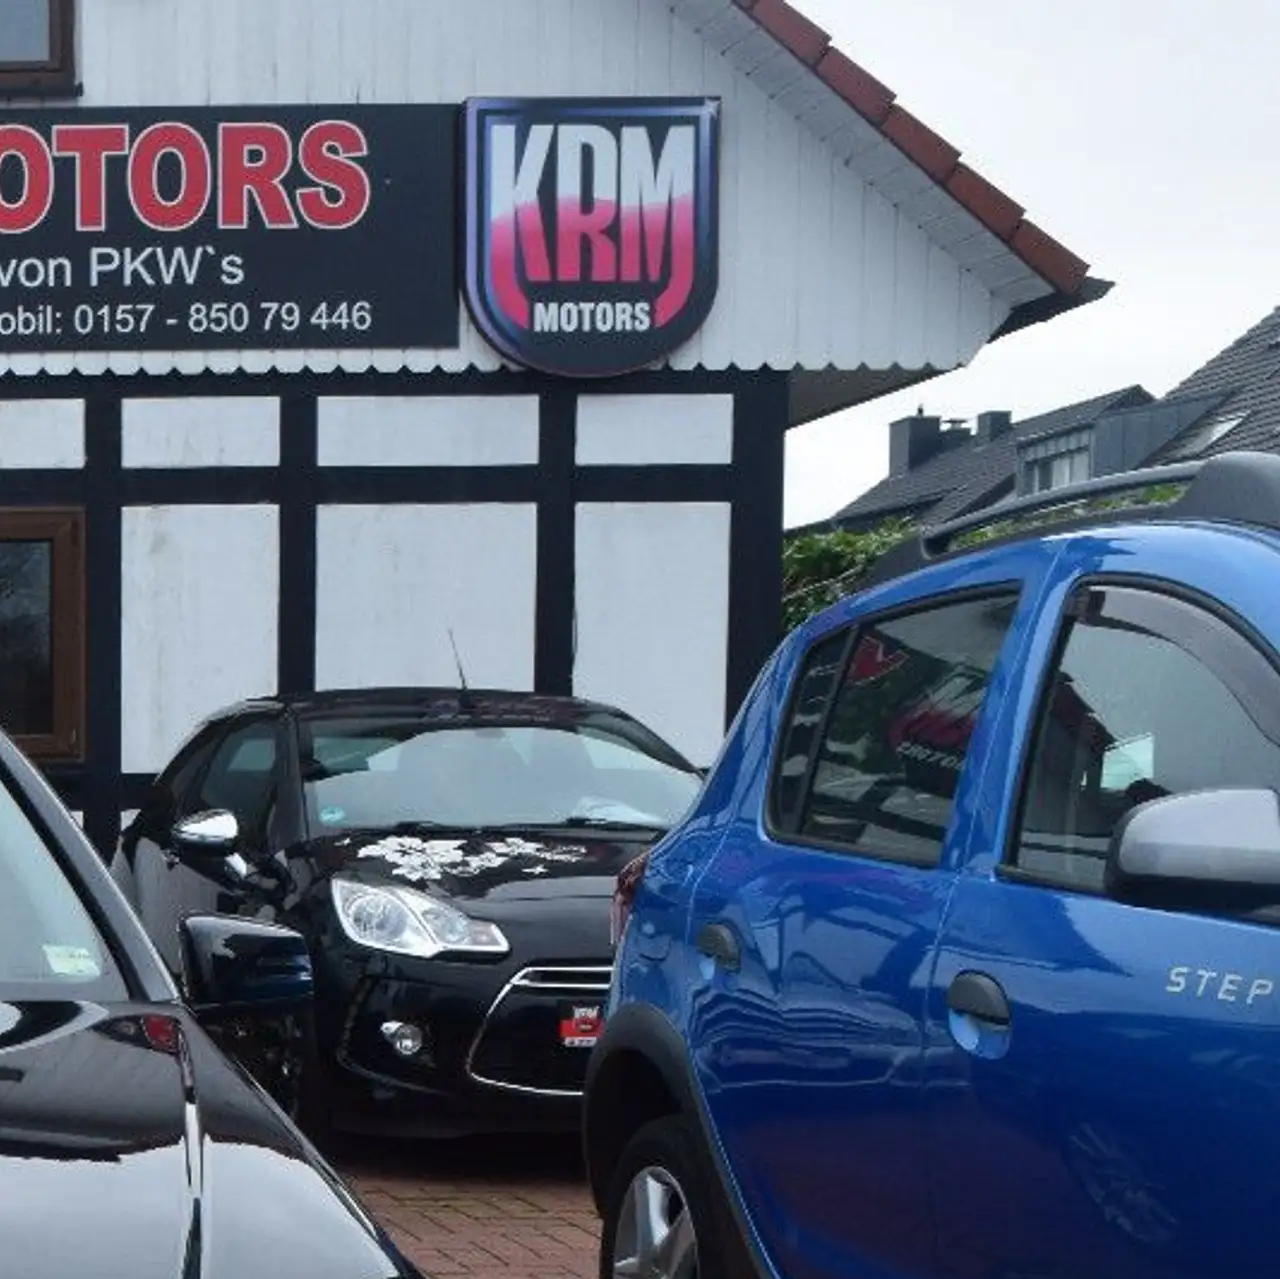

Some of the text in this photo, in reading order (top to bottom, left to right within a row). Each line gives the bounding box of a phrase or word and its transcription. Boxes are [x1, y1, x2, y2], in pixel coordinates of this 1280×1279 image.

[492, 124, 695, 329] KRM
[74, 303, 156, 334] 0157
[188, 302, 249, 333] 850
[260, 301, 300, 332] 79
[310, 300, 372, 331] 446
[533, 302, 651, 333] MOTORS
